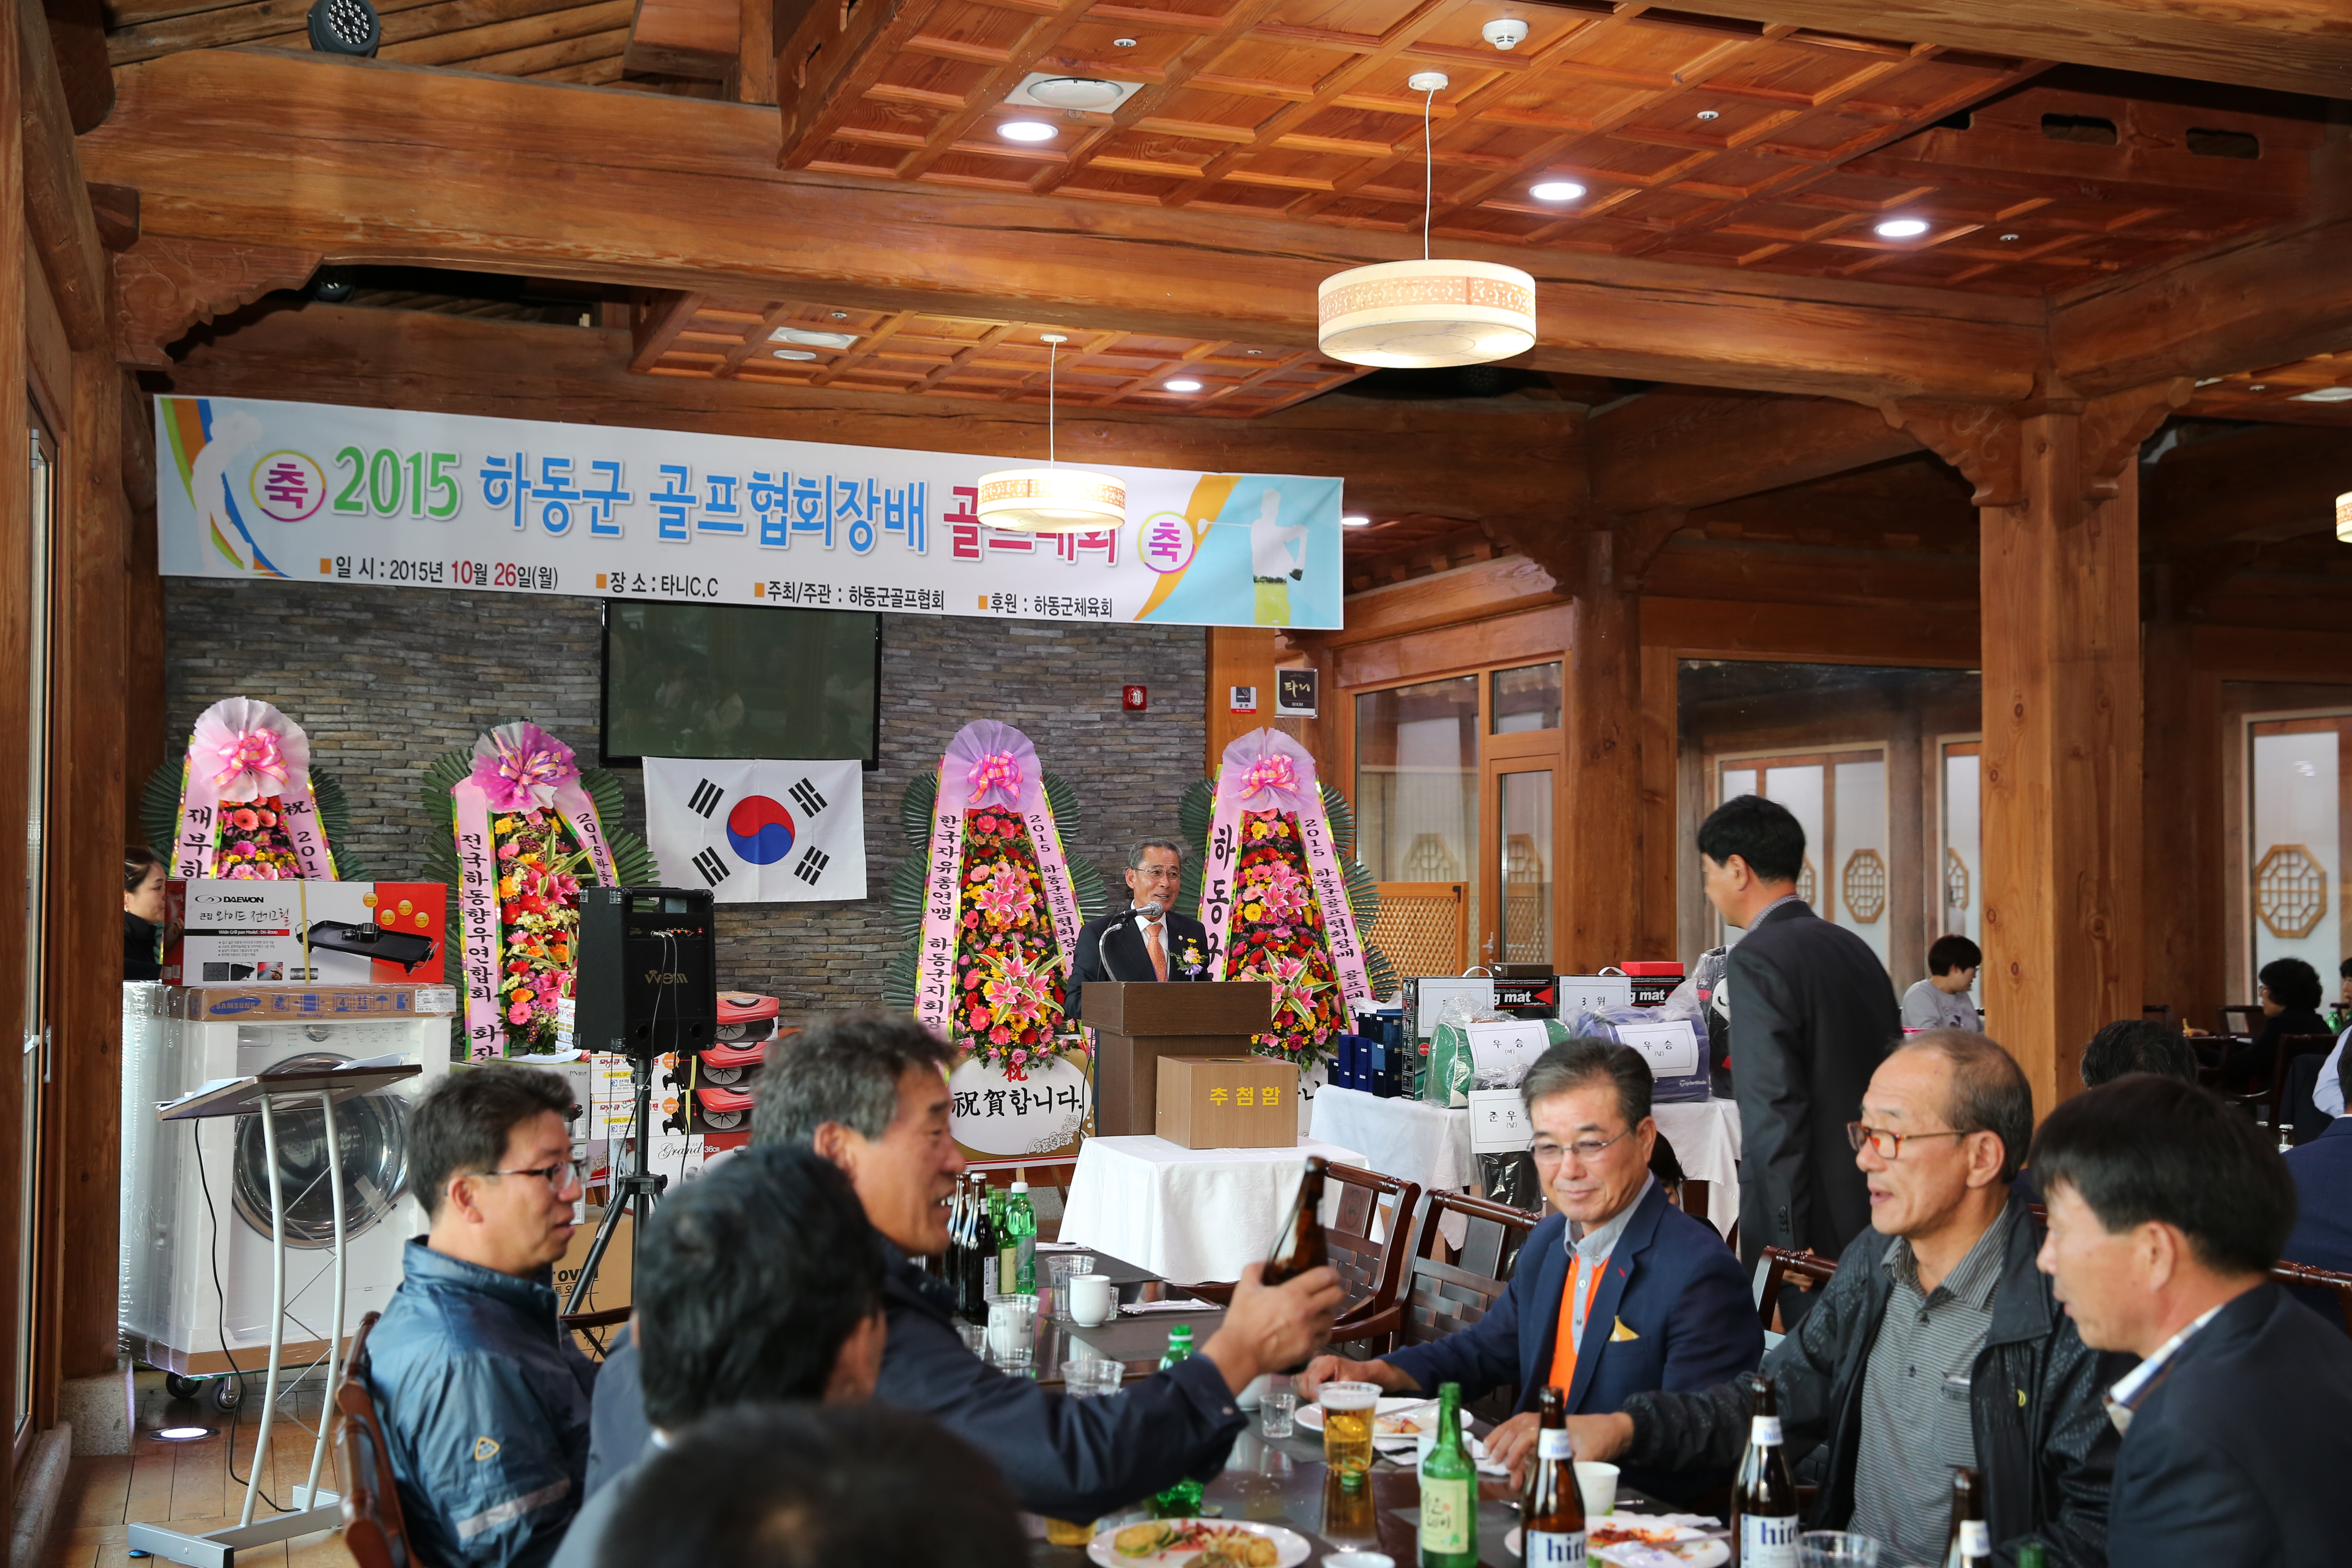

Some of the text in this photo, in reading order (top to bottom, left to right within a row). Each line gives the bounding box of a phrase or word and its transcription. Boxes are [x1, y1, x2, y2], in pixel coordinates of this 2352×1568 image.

[265, 462, 308, 509] 축
[333, 446, 457, 517] 2015
[480, 452, 630, 535] 하동군
[650, 464, 924, 552] 골프협회장배
[1149, 523, 1182, 562] 축
[390, 559, 443, 584] 2015년
[452, 561, 488, 586] 10월
[494, 563, 558, 590] 26일(월)
[661, 574, 717, 597] 타니C.C
[768, 580, 831, 603] 주최/주관
[849, 586, 944, 610] 하동군골프협회
[991, 593, 1018, 614] 후원
[1034, 595, 1112, 618] 하동군체육회
[1284, 680, 1310, 697] 타니
[1029, 814, 1051, 853] 2015
[1305, 819, 1325, 858] 2015
[217, 911, 246, 921] 와이드
[251, 908, 291, 927] 전기그릴
[922, 815, 962, 1030] 한국자유총연맹 하동군지회장
[1314, 868, 1355, 959] 하동군골프협회장배
[1504, 991, 1531, 1002] mat
[1582, 997, 1586, 1006] 3
[1639, 989, 1665, 1000] mat
[1209, 1086, 1281, 1106] 추첨함
[658, 1142, 703, 1160] Grand
